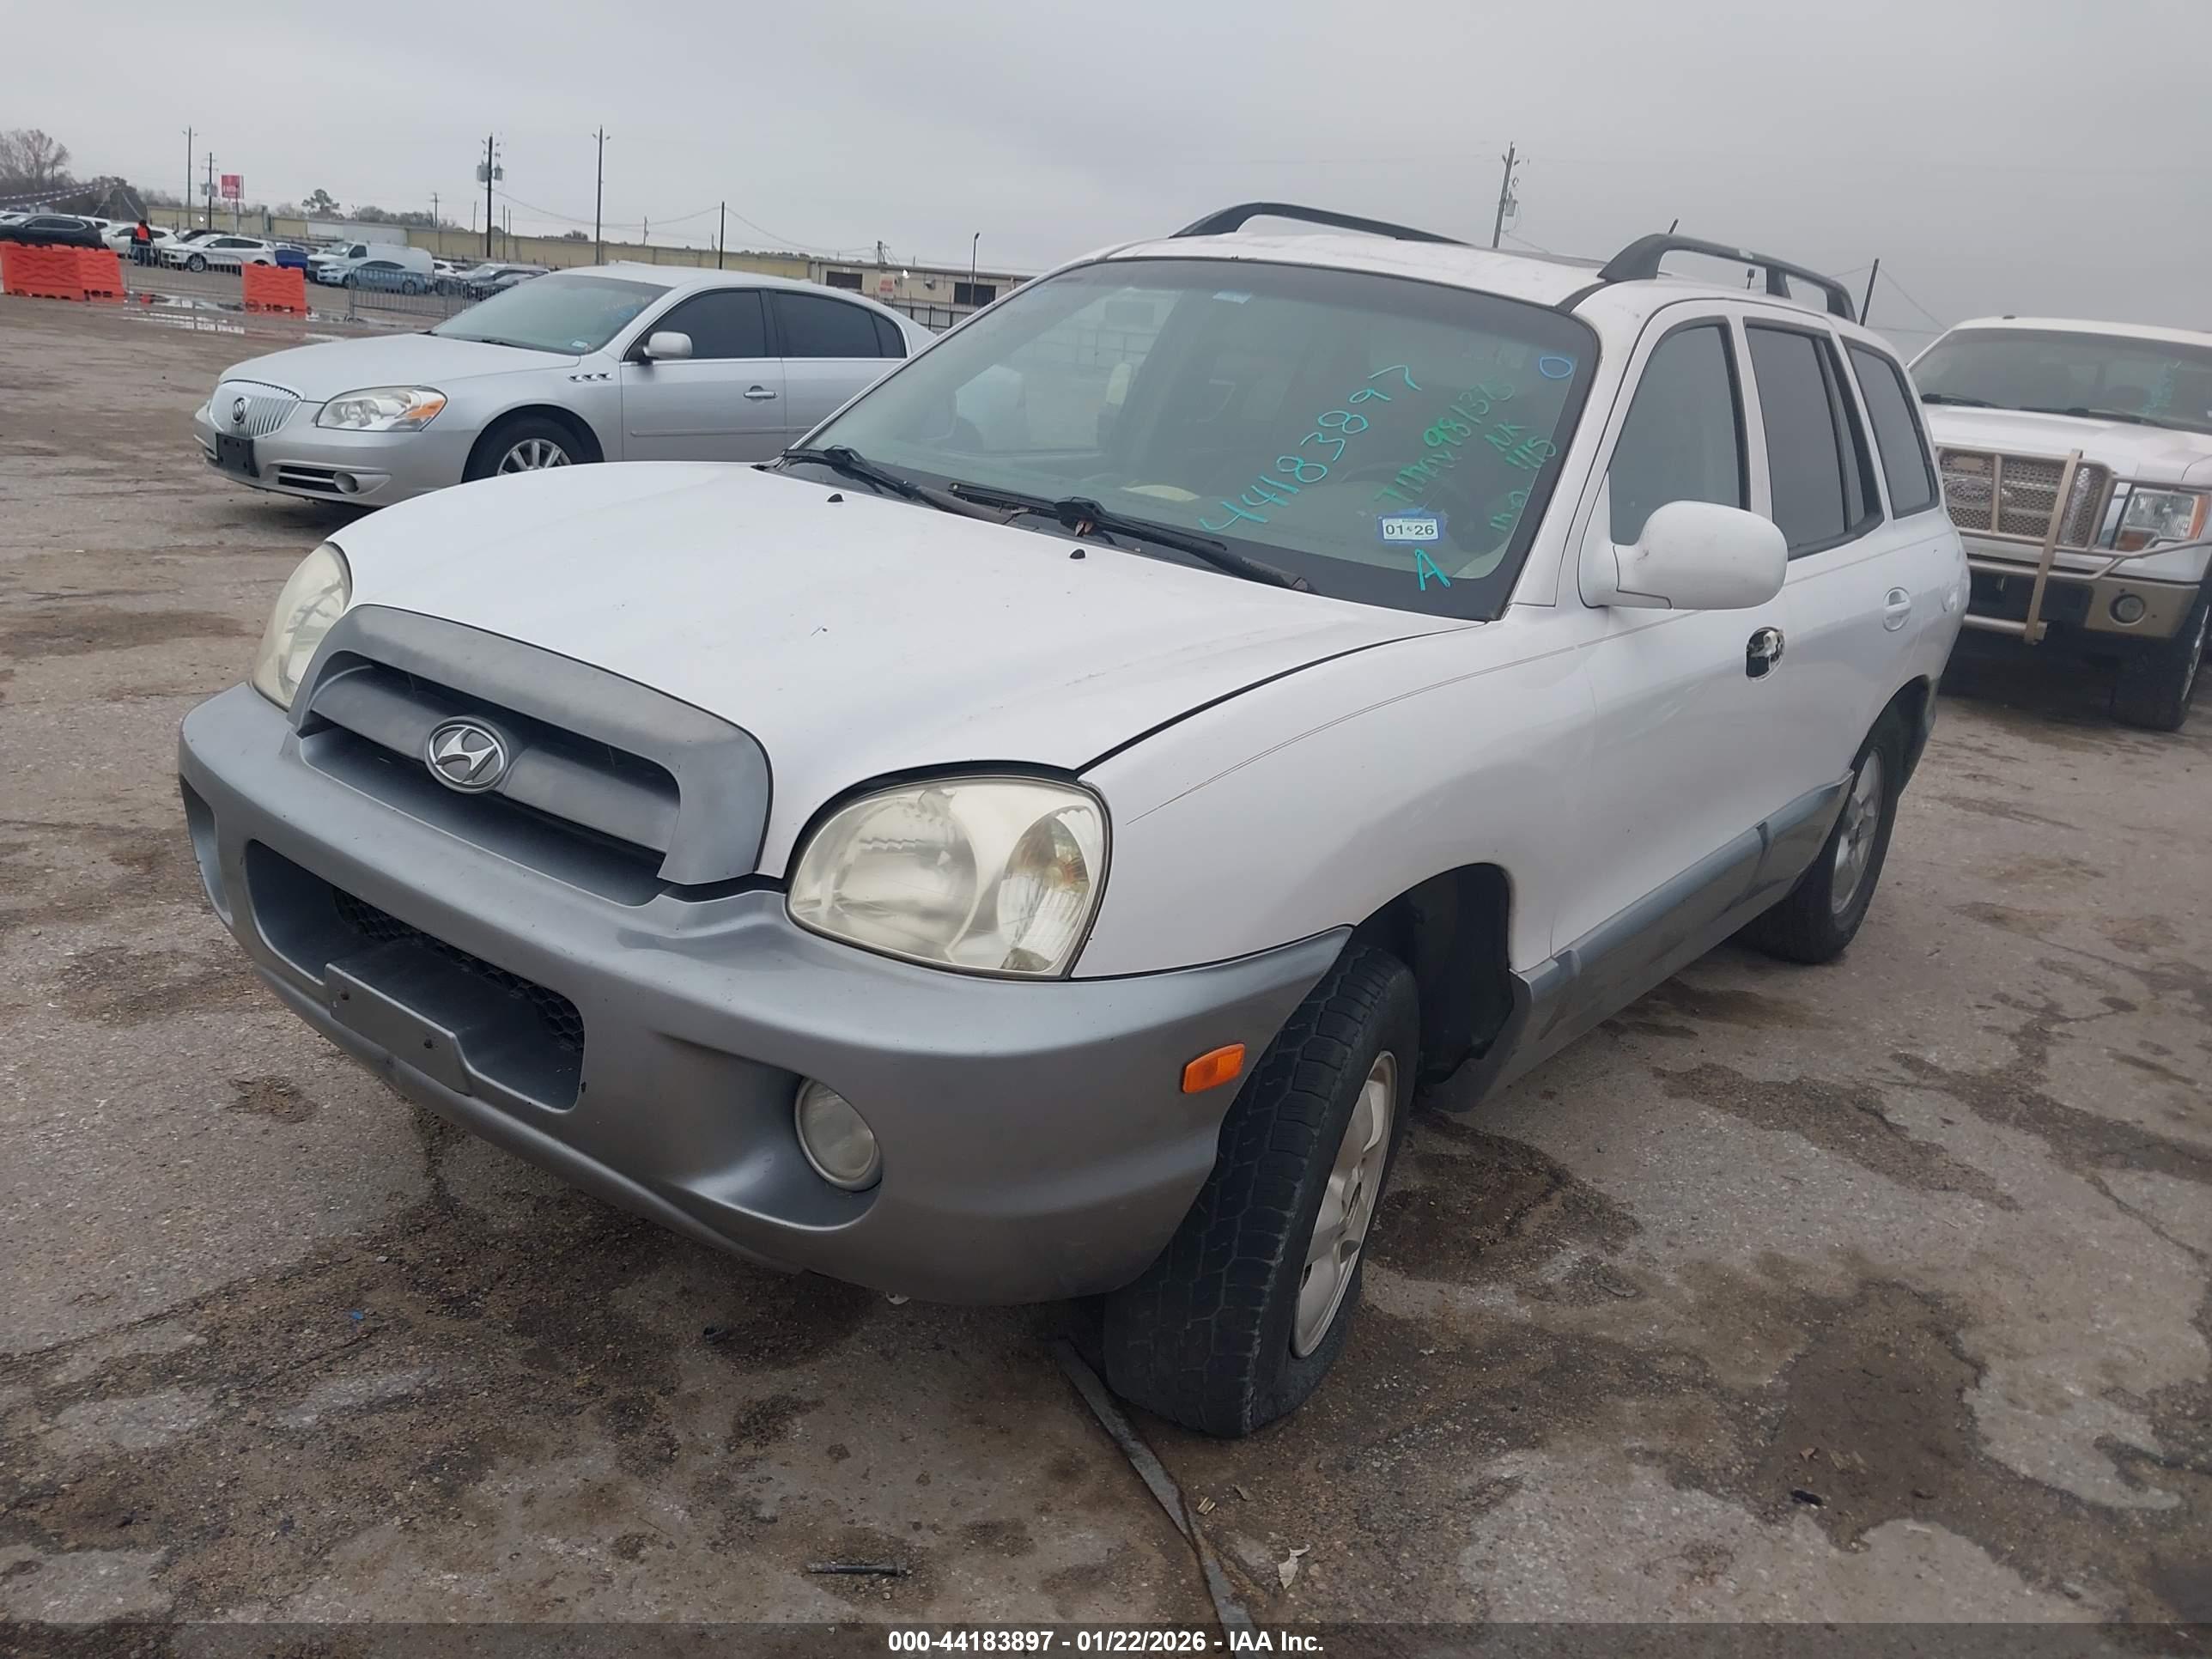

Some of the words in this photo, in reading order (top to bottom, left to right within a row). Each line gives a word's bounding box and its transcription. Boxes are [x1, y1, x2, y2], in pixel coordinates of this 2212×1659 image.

[1199, 364, 1422, 532] 44183897
[1385, 524, 1404, 535] 01
[1414, 525, 1435, 536] 26
[1414, 548, 1451, 591] A
